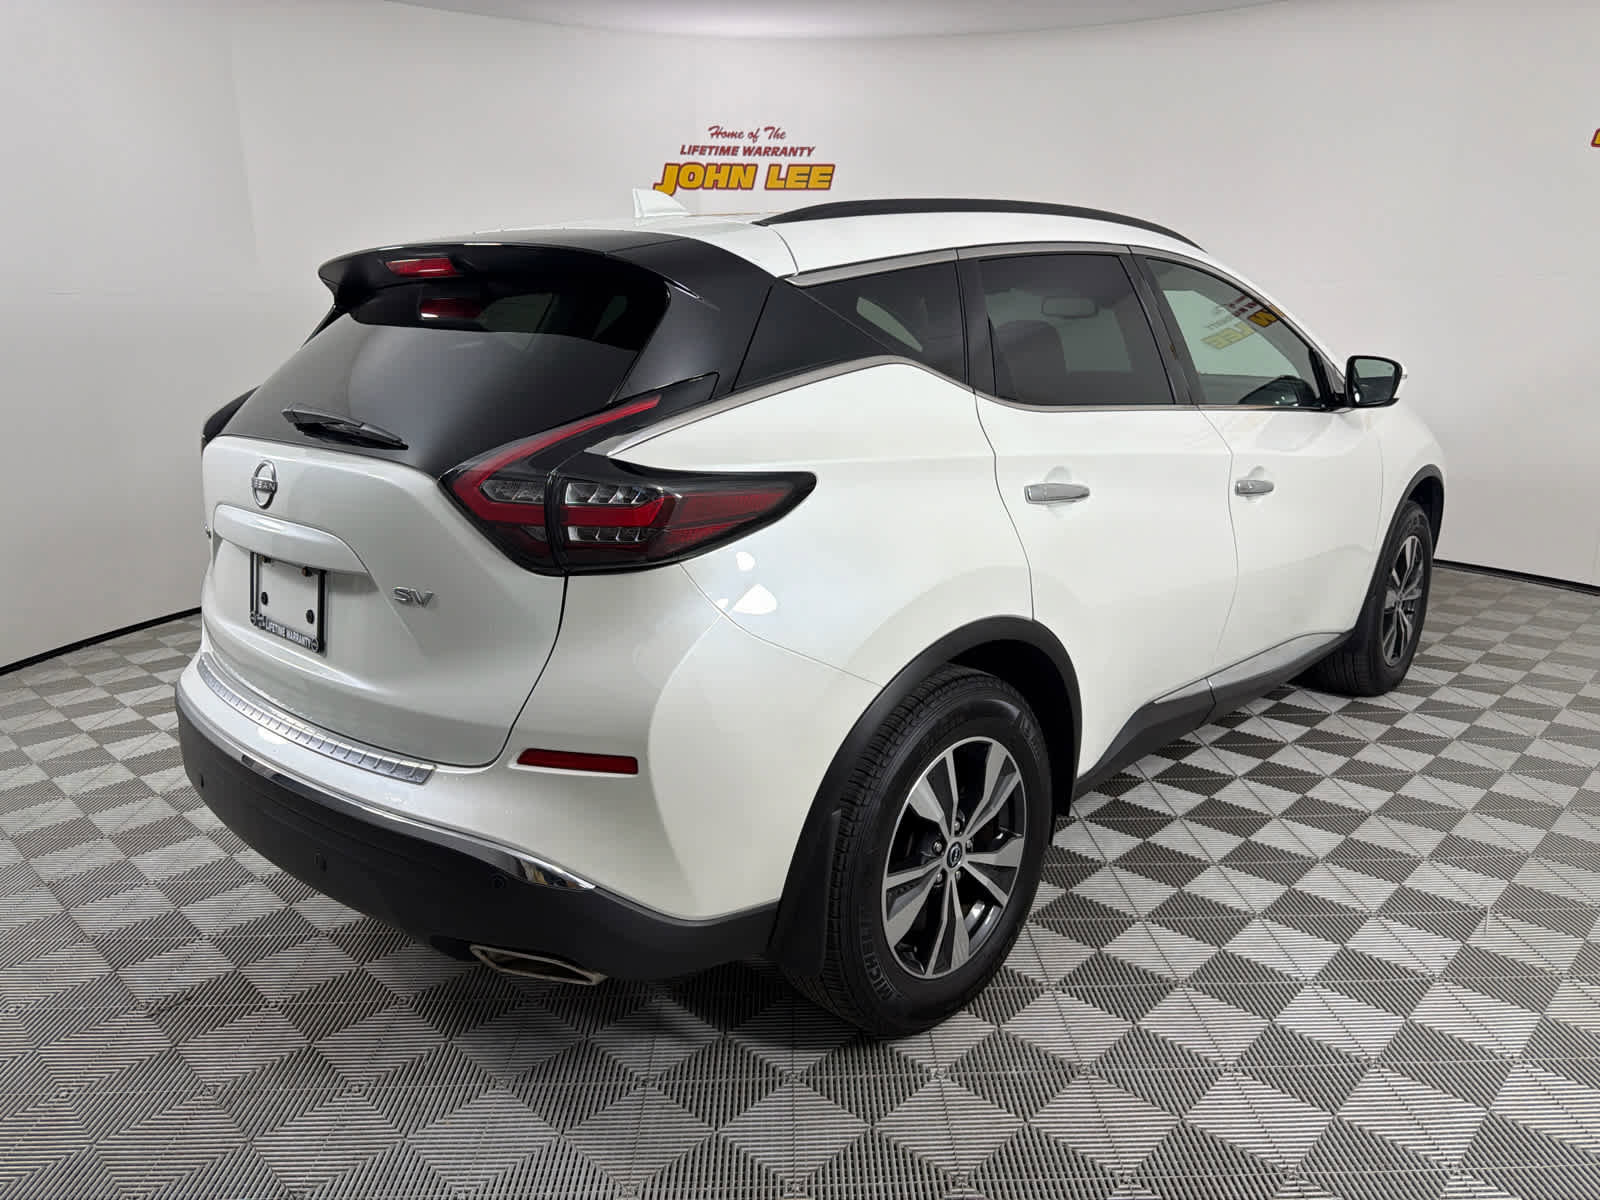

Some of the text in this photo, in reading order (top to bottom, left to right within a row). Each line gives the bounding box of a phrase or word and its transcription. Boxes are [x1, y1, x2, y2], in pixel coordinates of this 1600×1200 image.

[707, 125, 787, 143] Home of The
[679, 144, 816, 157] LIFETIME WARRANTY
[653, 162, 836, 196] JOHN LEE
[392, 586, 434, 608] SV
[265, 618, 286, 638] LIFETIME
[286, 629, 311, 649] WARRANTY
